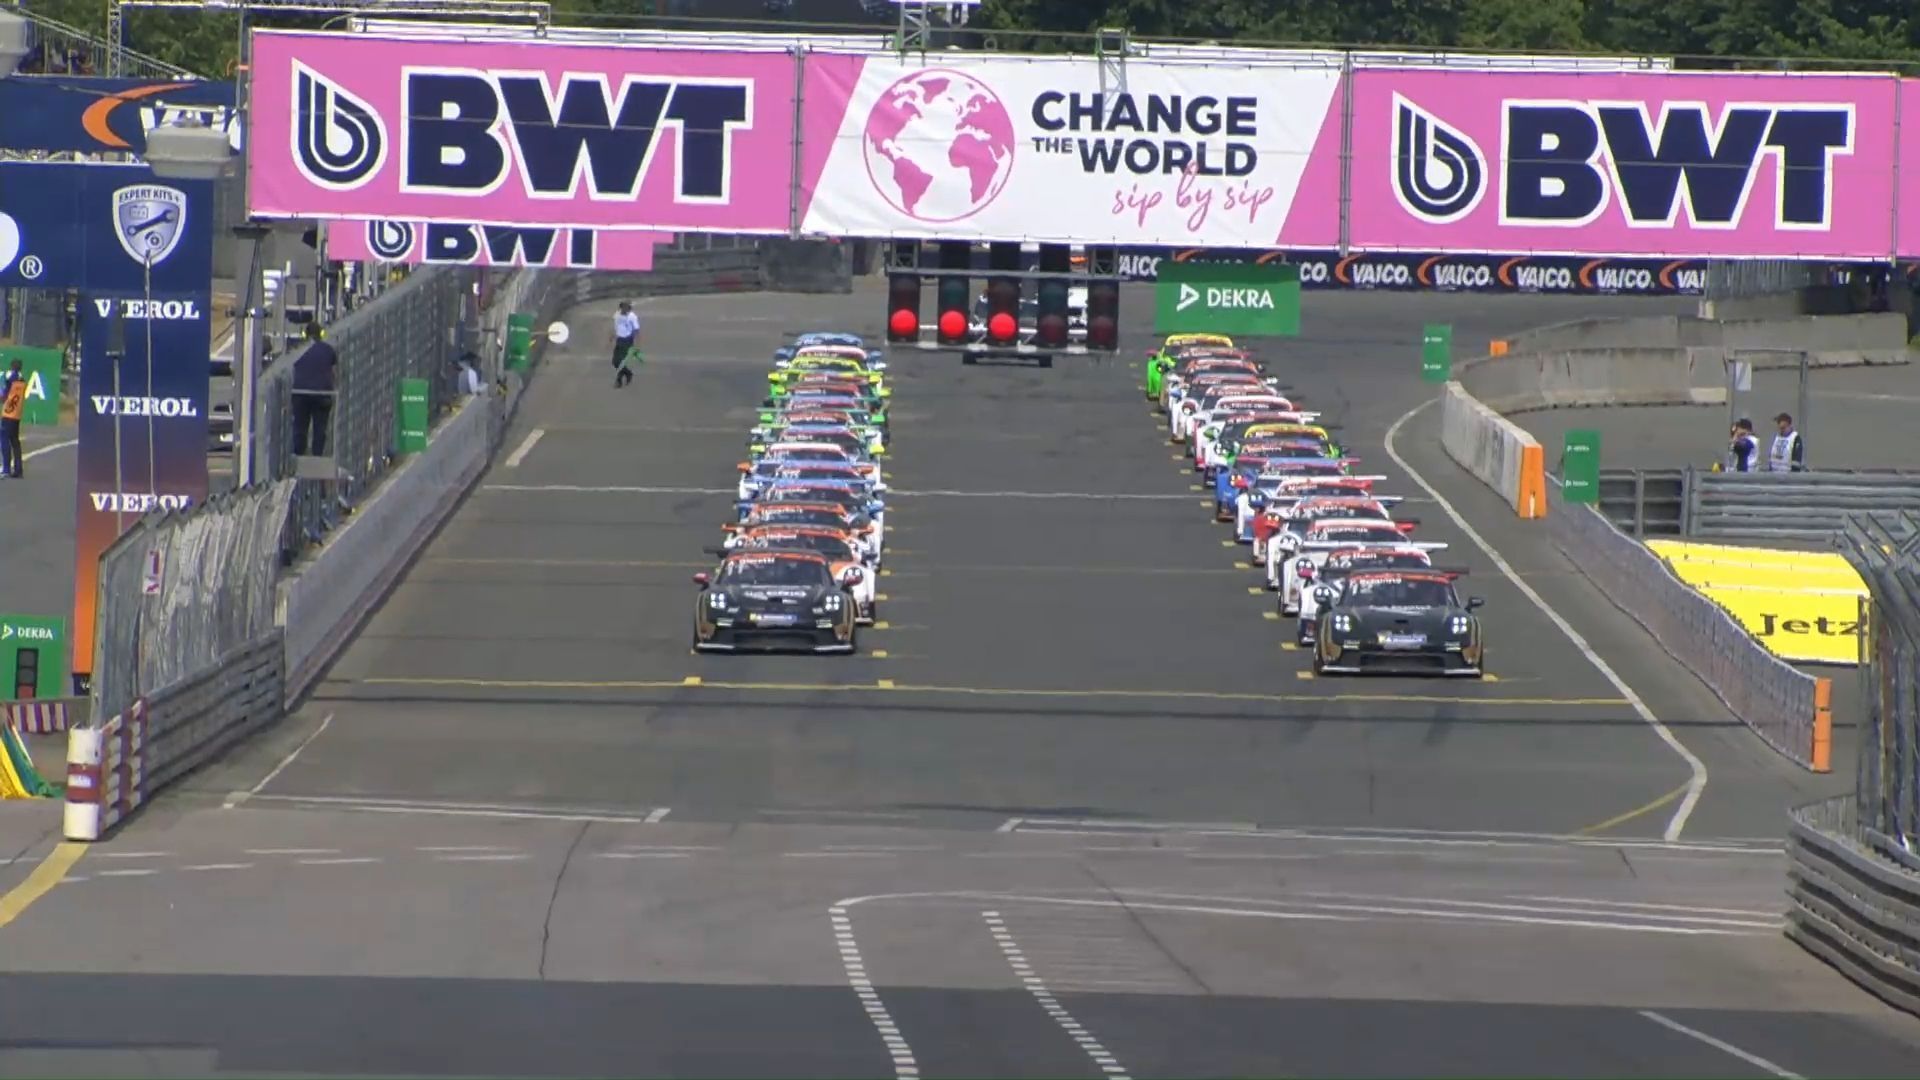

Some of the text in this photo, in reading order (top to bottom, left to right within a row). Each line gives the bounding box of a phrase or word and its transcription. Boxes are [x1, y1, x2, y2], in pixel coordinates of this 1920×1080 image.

[1031, 91, 1258, 136] CHANGE
[400, 66, 754, 205] BWT
[1032, 137, 1258, 177] THE WORLD
[1498, 99, 1856, 231] BWT
[119, 188, 151, 201] EXPERT
[153, 189, 173, 200] KITS
[1112, 160, 1274, 232] sip by sip
[94, 299, 200, 320] VEROL
[1207, 287, 1275, 309] DEKRA
[17, 627, 54, 640] DEKRA
